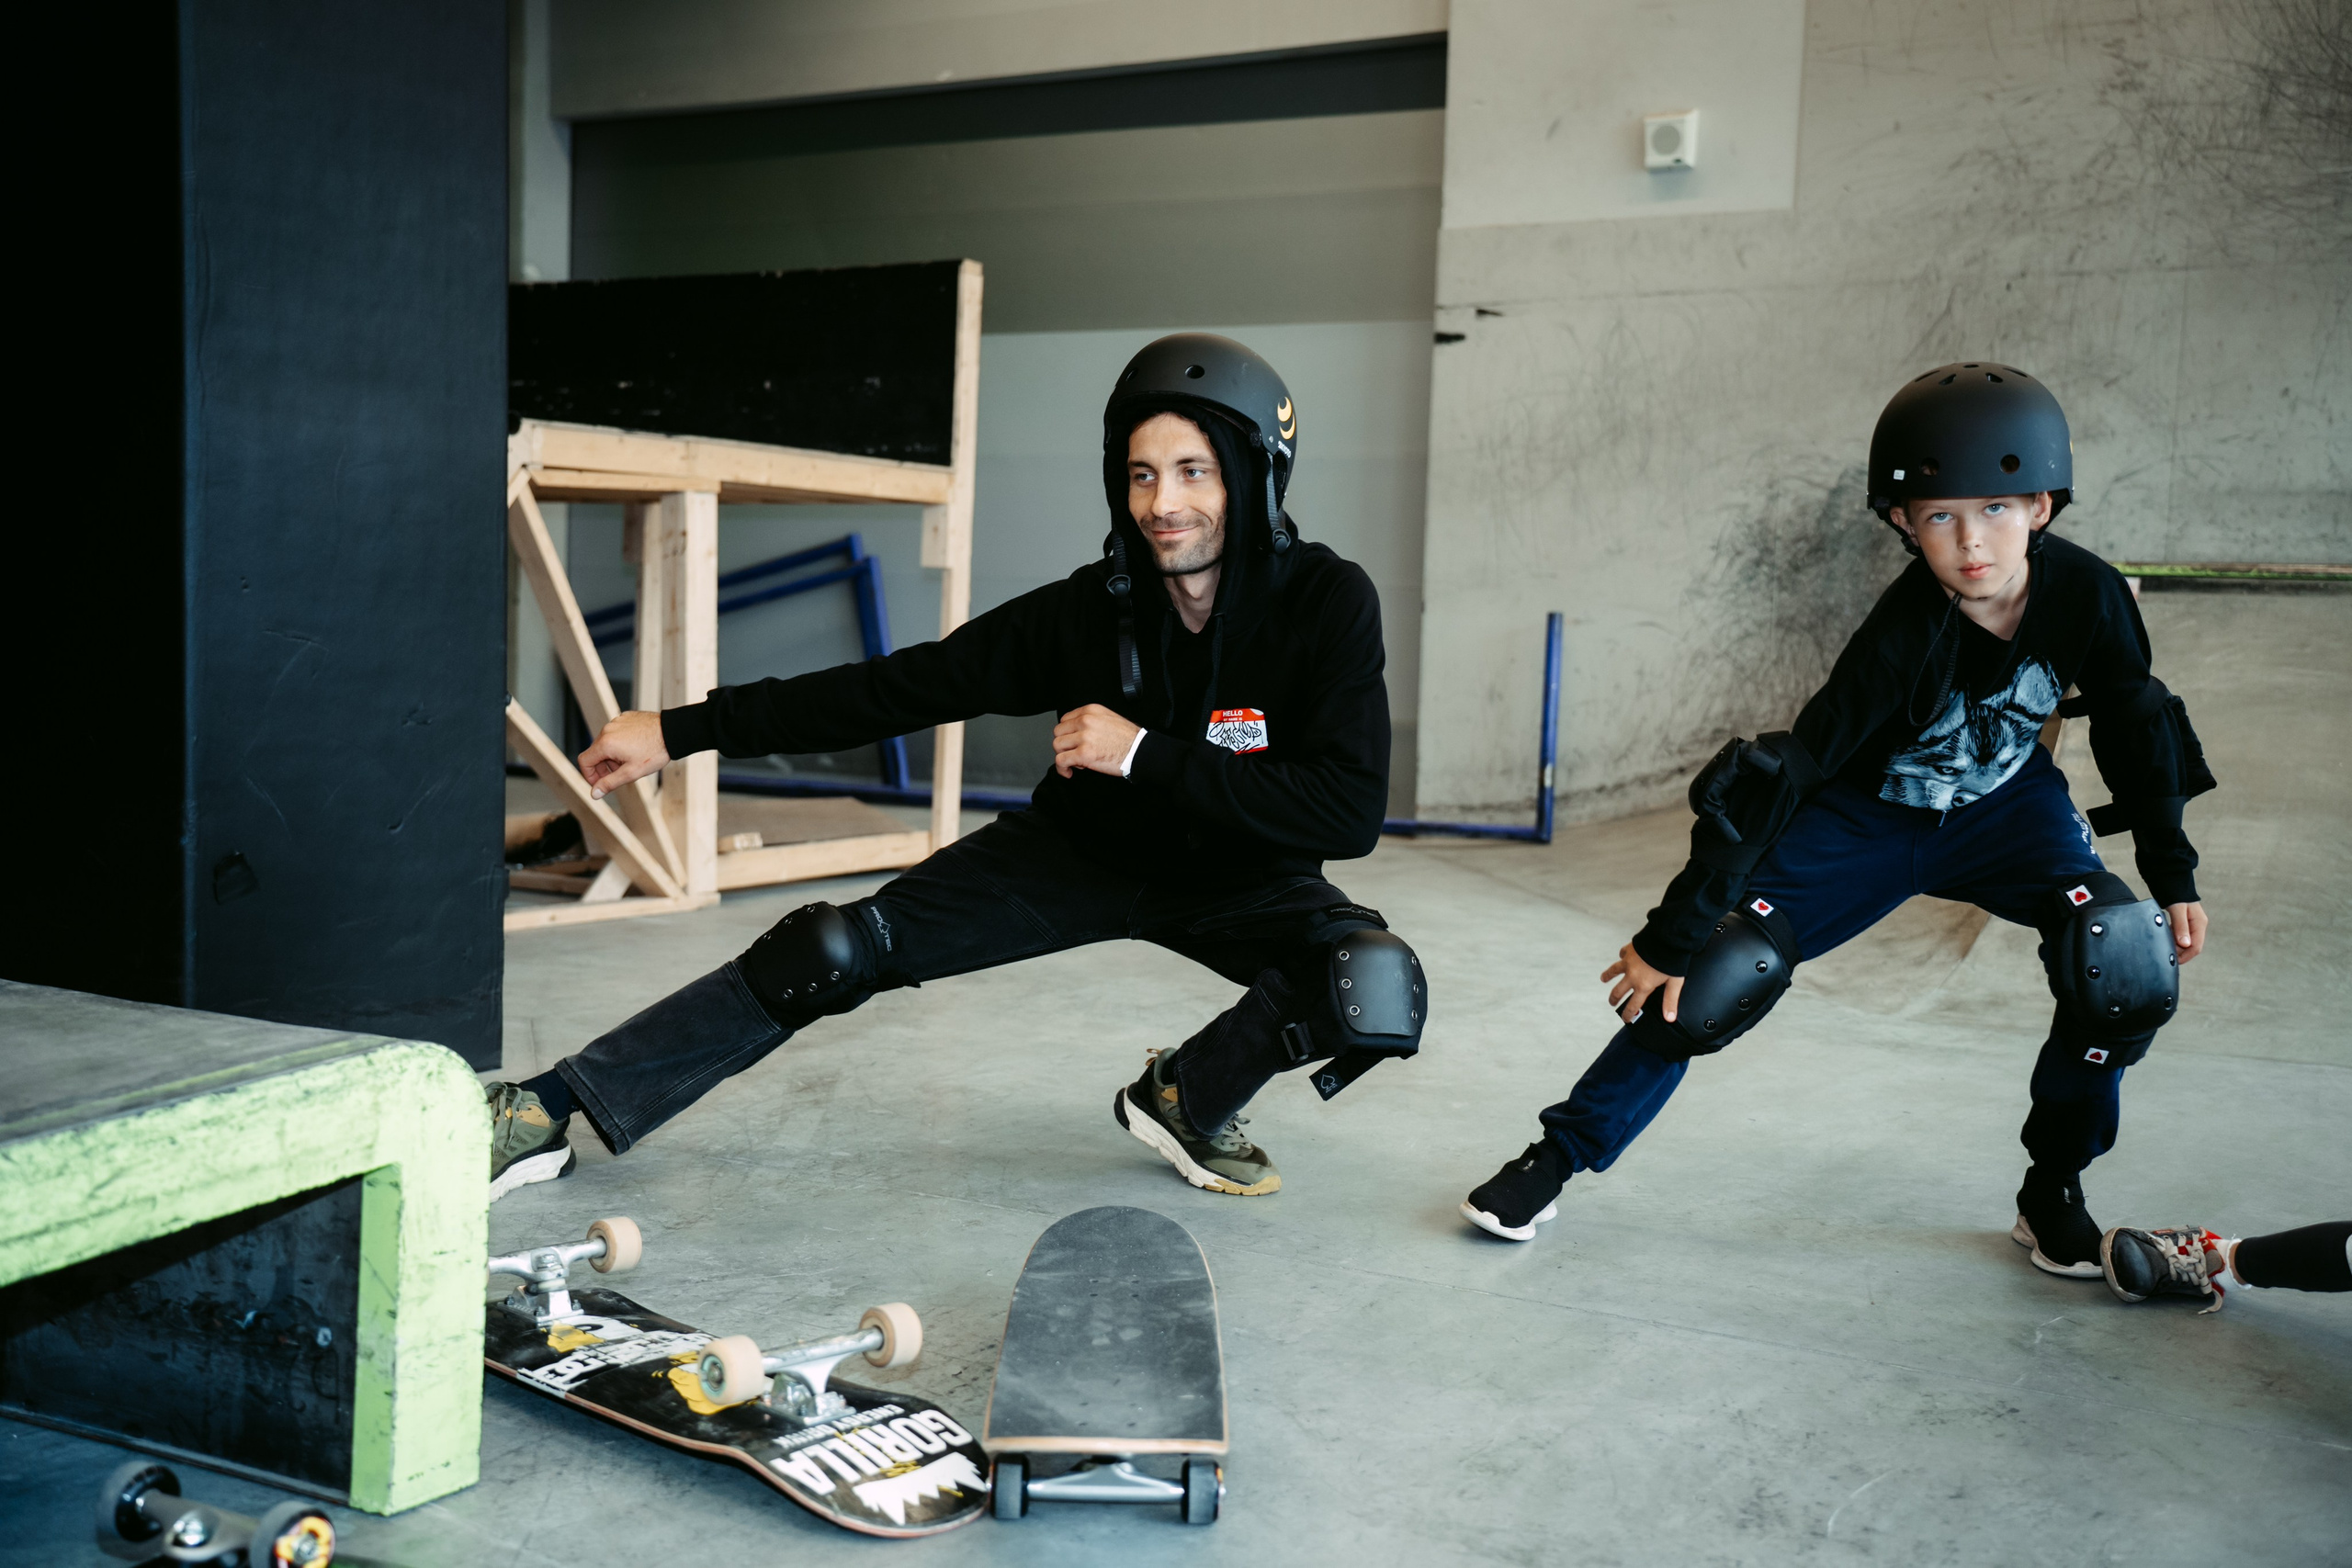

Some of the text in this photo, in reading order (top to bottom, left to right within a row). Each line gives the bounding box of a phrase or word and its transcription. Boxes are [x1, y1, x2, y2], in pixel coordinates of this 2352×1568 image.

[769, 1409, 973, 1495] GORILLA
[772, 1404, 905, 1449] ENERGY DRINK
